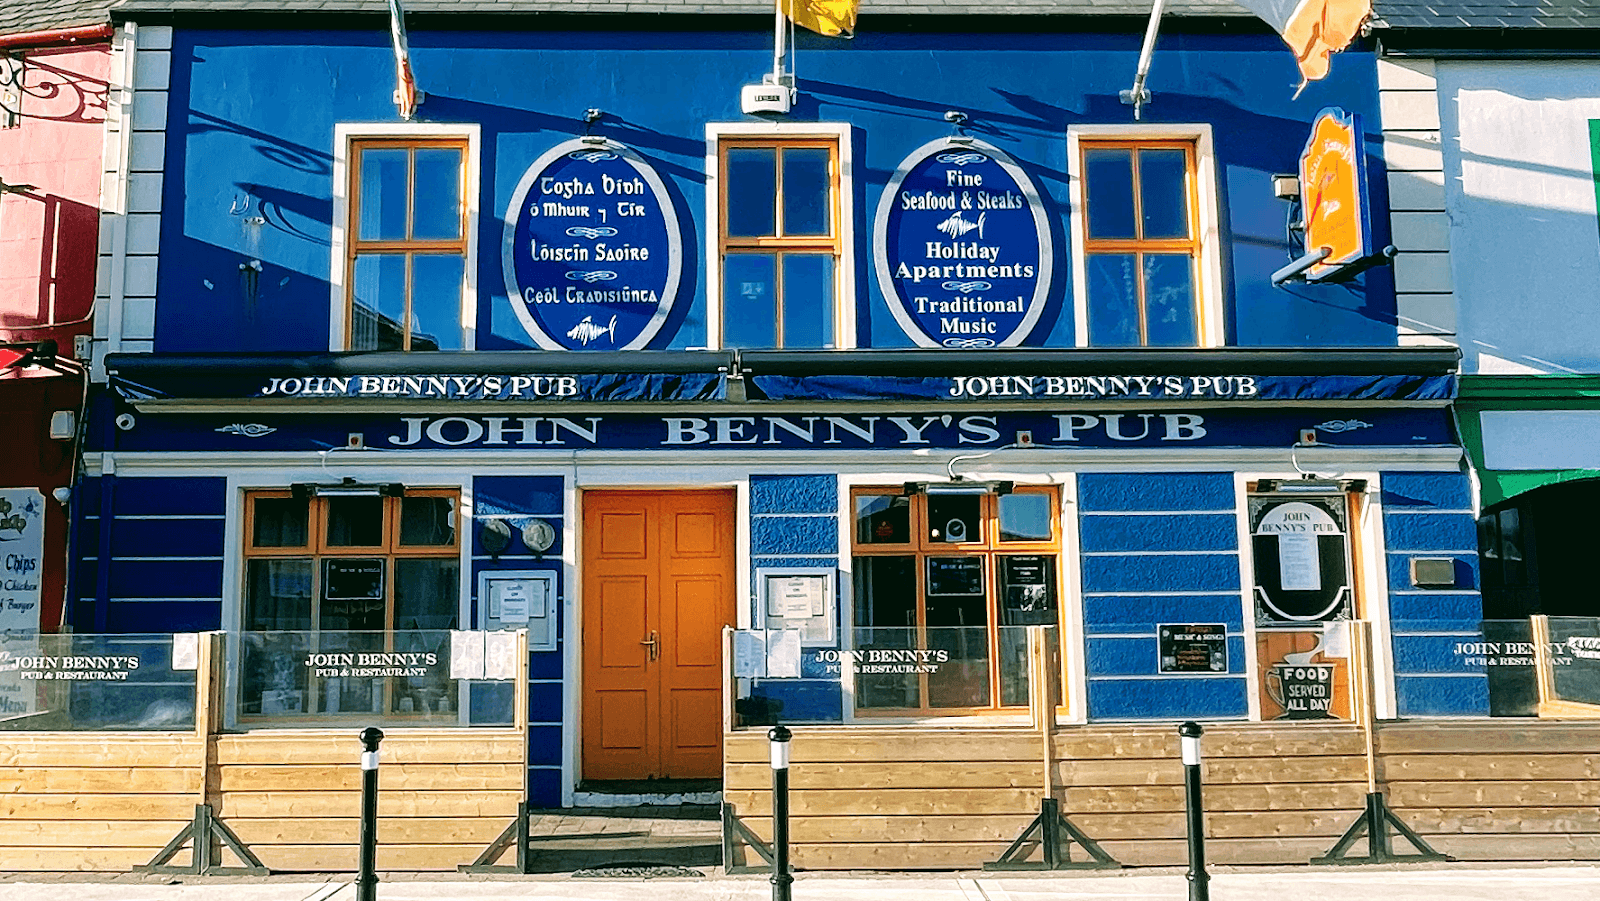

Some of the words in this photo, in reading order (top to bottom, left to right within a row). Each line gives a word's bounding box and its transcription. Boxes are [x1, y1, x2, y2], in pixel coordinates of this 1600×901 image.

[945, 169, 983, 187] Fine
[540, 176, 595, 199] Togha
[901, 190, 956, 210] Seafood
[960, 191, 973, 210] &
[977, 190, 1022, 210] Steaks
[543, 202, 590, 217] Mhuir
[925, 241, 1001, 263] Holiday
[894, 261, 1034, 283] Apartments
[914, 296, 1024, 314] Traditional
[940, 317, 997, 334] Music
[261, 376, 352, 395] JOHN
[358, 375, 501, 396] BENNY'S
[510, 376, 577, 396] PUB
[949, 375, 1034, 396] JOHN
[1043, 375, 1184, 396] BENNY'S
[1190, 375, 1258, 396] PUB
[388, 416, 603, 446] JOHN
[660, 413, 1001, 445] BENNY'S
[1051, 413, 1208, 441] PUB
[1282, 512, 1311, 522] JOHN
[1262, 523, 1306, 532] BENNY'S
[1312, 523, 1334, 532] PUB
[5, 553, 37, 575] Chips
[868, 649, 949, 663] BENNY'S
[1453, 642, 1500, 655] JOHN
[11, 656, 59, 669] JOHN
[61, 656, 139, 669] BENNY'S
[304, 652, 354, 667] JOHN
[358, 652, 438, 666] BENNY'S
[1464, 657, 1487, 666] PUB
[1488, 657, 1498, 666] &
[20, 671, 43, 680] PUB
[44, 671, 53, 680] &
[55, 671, 129, 680] RESTAURANT
[315, 667, 338, 677] PUB
[339, 667, 350, 677] &
[351, 667, 427, 677] RESTAURANT
[862, 664, 939, 674] RESTAURANT
[1284, 667, 1329, 681] FOOD
[1288, 684, 1326, 698] SERVED
[1286, 698, 1307, 711] ALL
[1310, 698, 1331, 711] DAY
